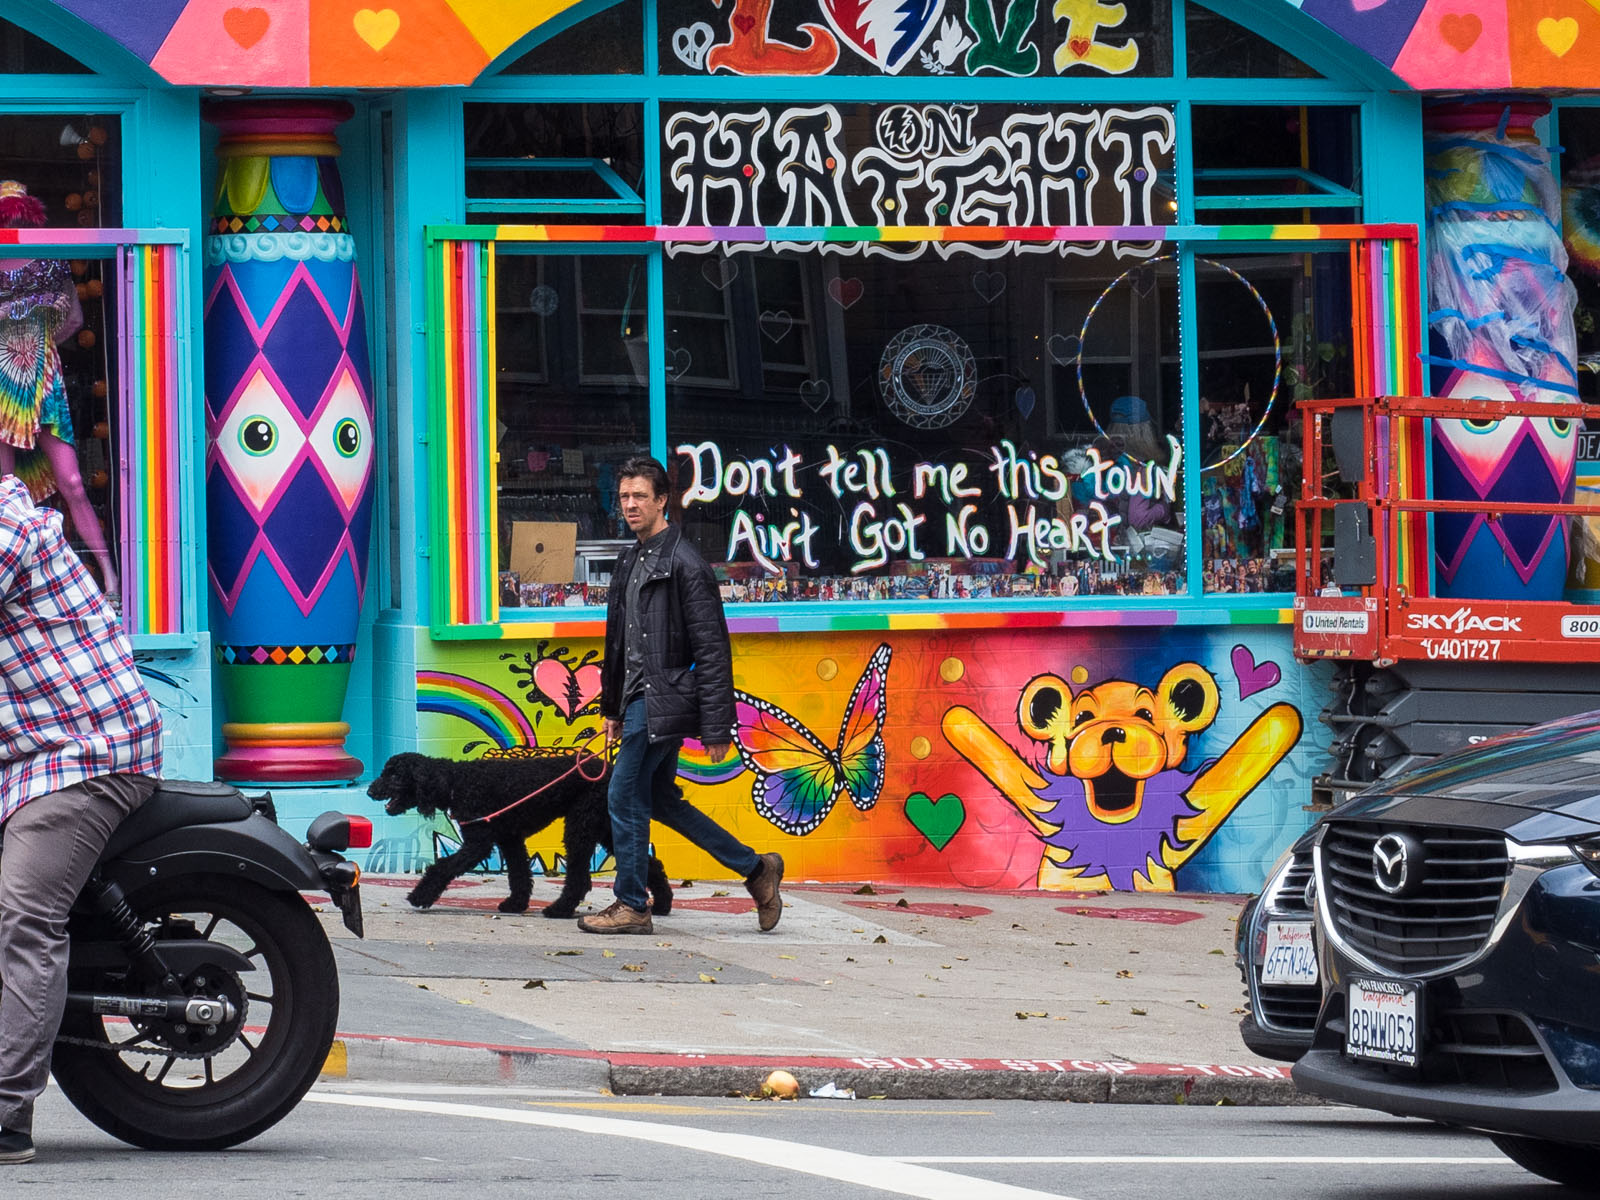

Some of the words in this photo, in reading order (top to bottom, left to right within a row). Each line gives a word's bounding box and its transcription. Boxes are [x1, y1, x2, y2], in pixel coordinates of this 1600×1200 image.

[876, 104, 978, 158] ON
[666, 104, 1175, 261] HAIGHT
[676, 441, 802, 509] Don't
[820, 444, 895, 500] tell
[914, 461, 982, 503] me
[991, 438, 1068, 500] this
[850, 502, 927, 574] Got
[948, 504, 990, 560] No
[1315, 616, 1338, 628] United
[1340, 616, 1364, 629] Rentals
[1407, 606, 1522, 634] SKYJACK
[1371, 980, 1402, 995] FRANCISCO
[1352, 1008, 1415, 1052] 8BWW053
[852, 1057, 974, 1070] BUS
[1000, 1059, 1137, 1075] STOP
[1347, 1043, 1363, 1057] Royal
[1363, 1047, 1396, 1061] Automotive
[1396, 1051, 1415, 1066] Group
